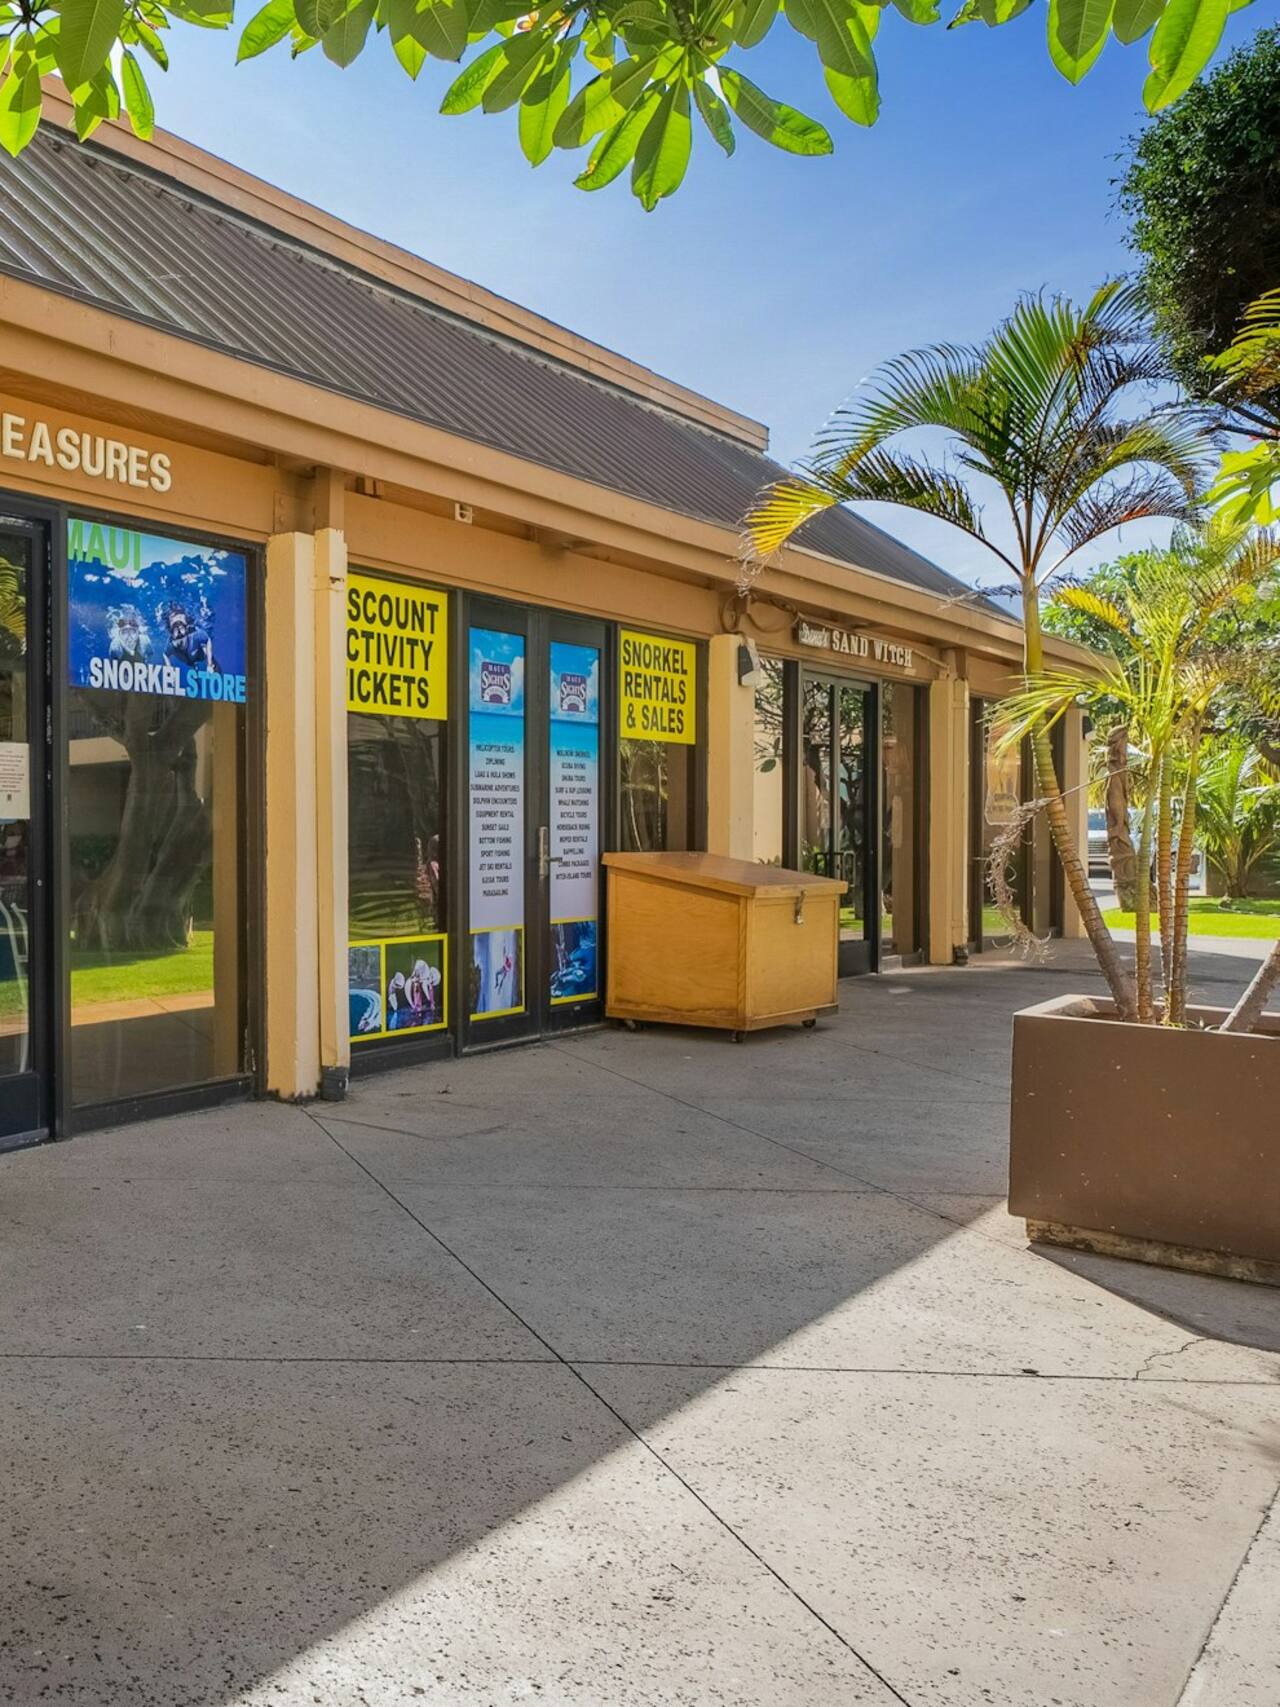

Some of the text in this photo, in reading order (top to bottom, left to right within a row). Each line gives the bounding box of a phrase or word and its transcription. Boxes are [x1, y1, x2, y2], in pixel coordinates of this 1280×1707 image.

[347, 588, 439, 634] SCOUNT
[623, 639, 688, 675] SNORKEL
[832, 630, 868, 657] SAND
[873, 640, 913, 667] WITCH
[90, 656, 247, 703] SNORKEL STORE
[347, 668, 429, 708] ICKETS
[481, 671, 510, 692] SIGHTS
[560, 681, 586, 700] SIGHTS
[624, 671, 686, 705] RENTALS
[626, 703, 684, 734] & SALES
